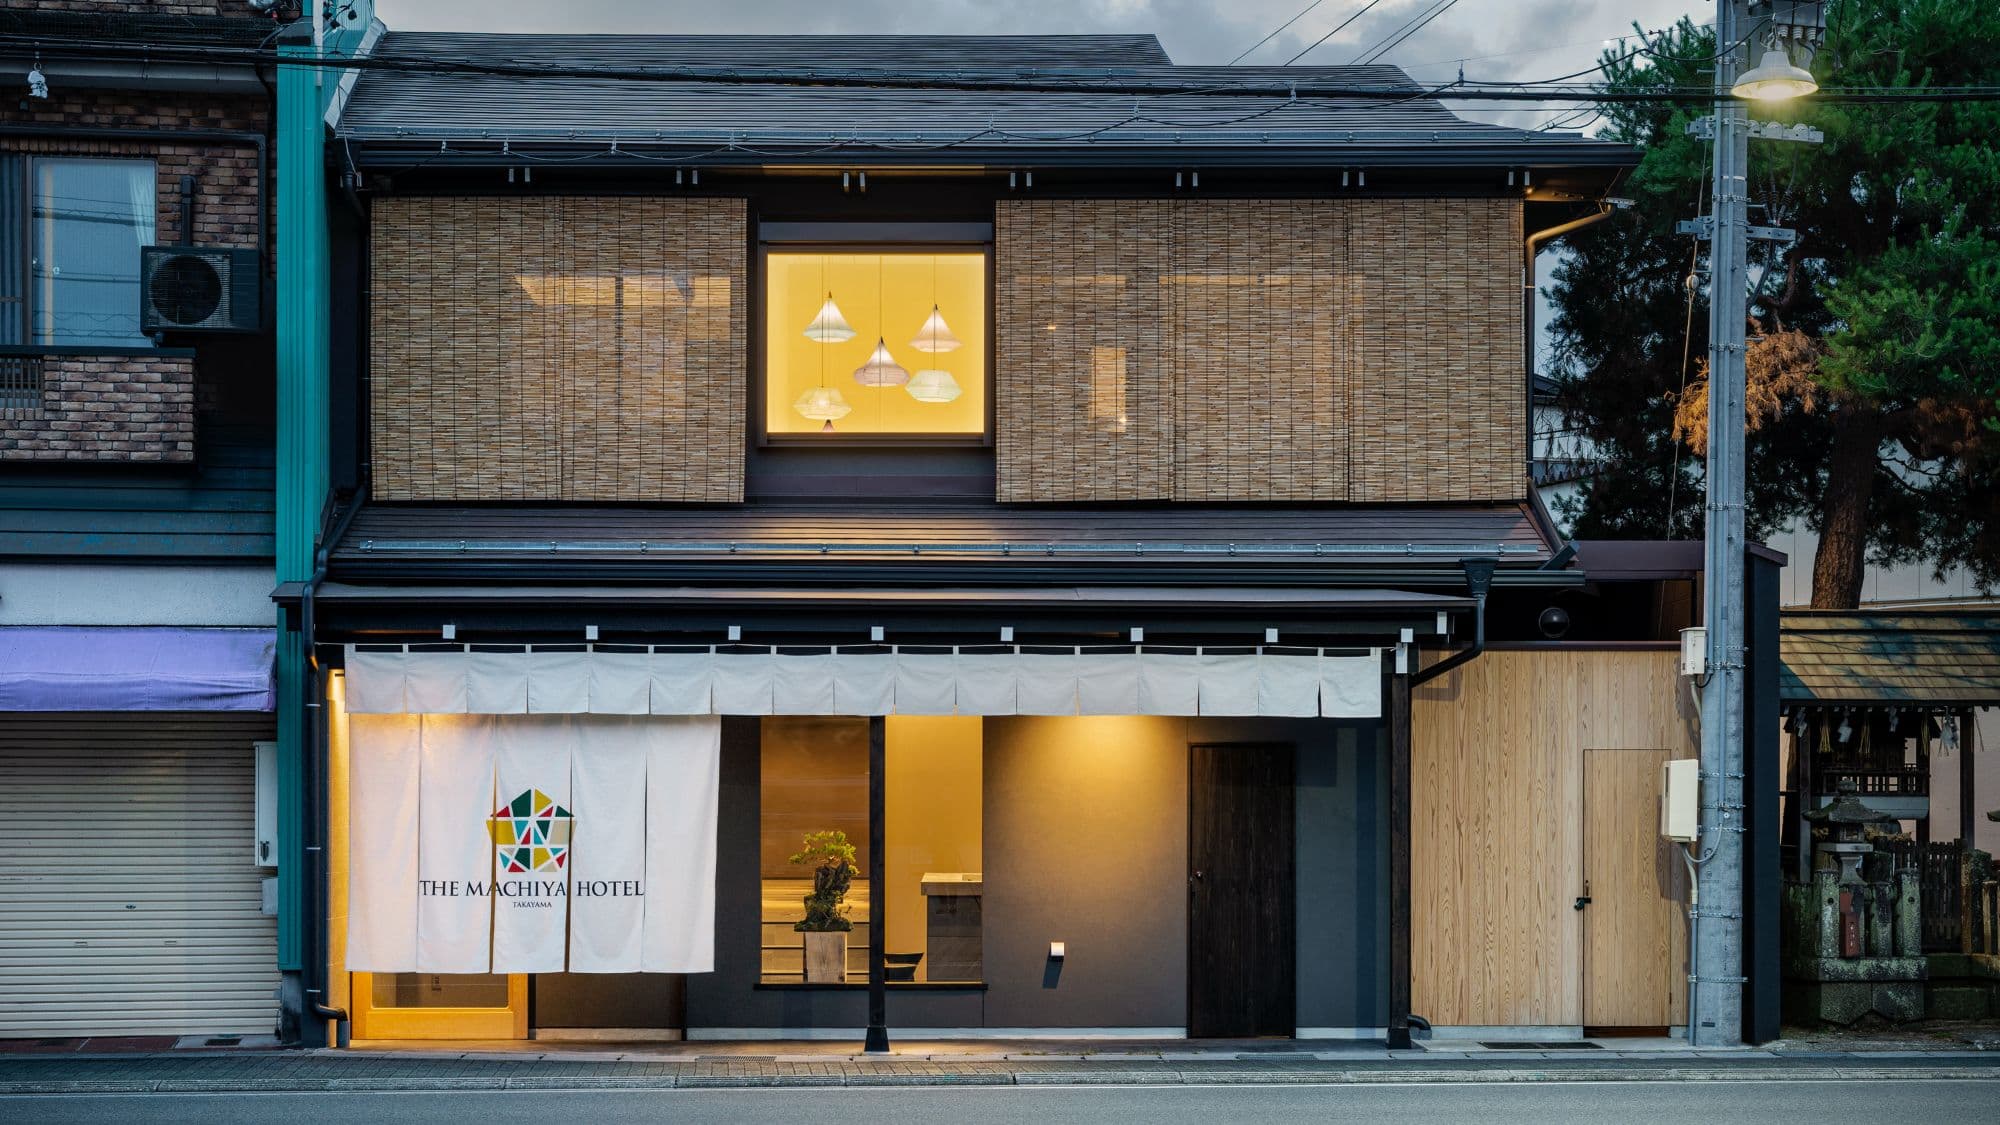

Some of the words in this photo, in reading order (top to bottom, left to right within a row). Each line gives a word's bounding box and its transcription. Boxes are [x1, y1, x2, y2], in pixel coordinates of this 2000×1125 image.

[419, 880, 459, 897] THE
[466, 880, 566, 897] MACHIYA
[577, 880, 645, 897] HOTEL
[513, 901, 552, 909] TAKAYAMA
